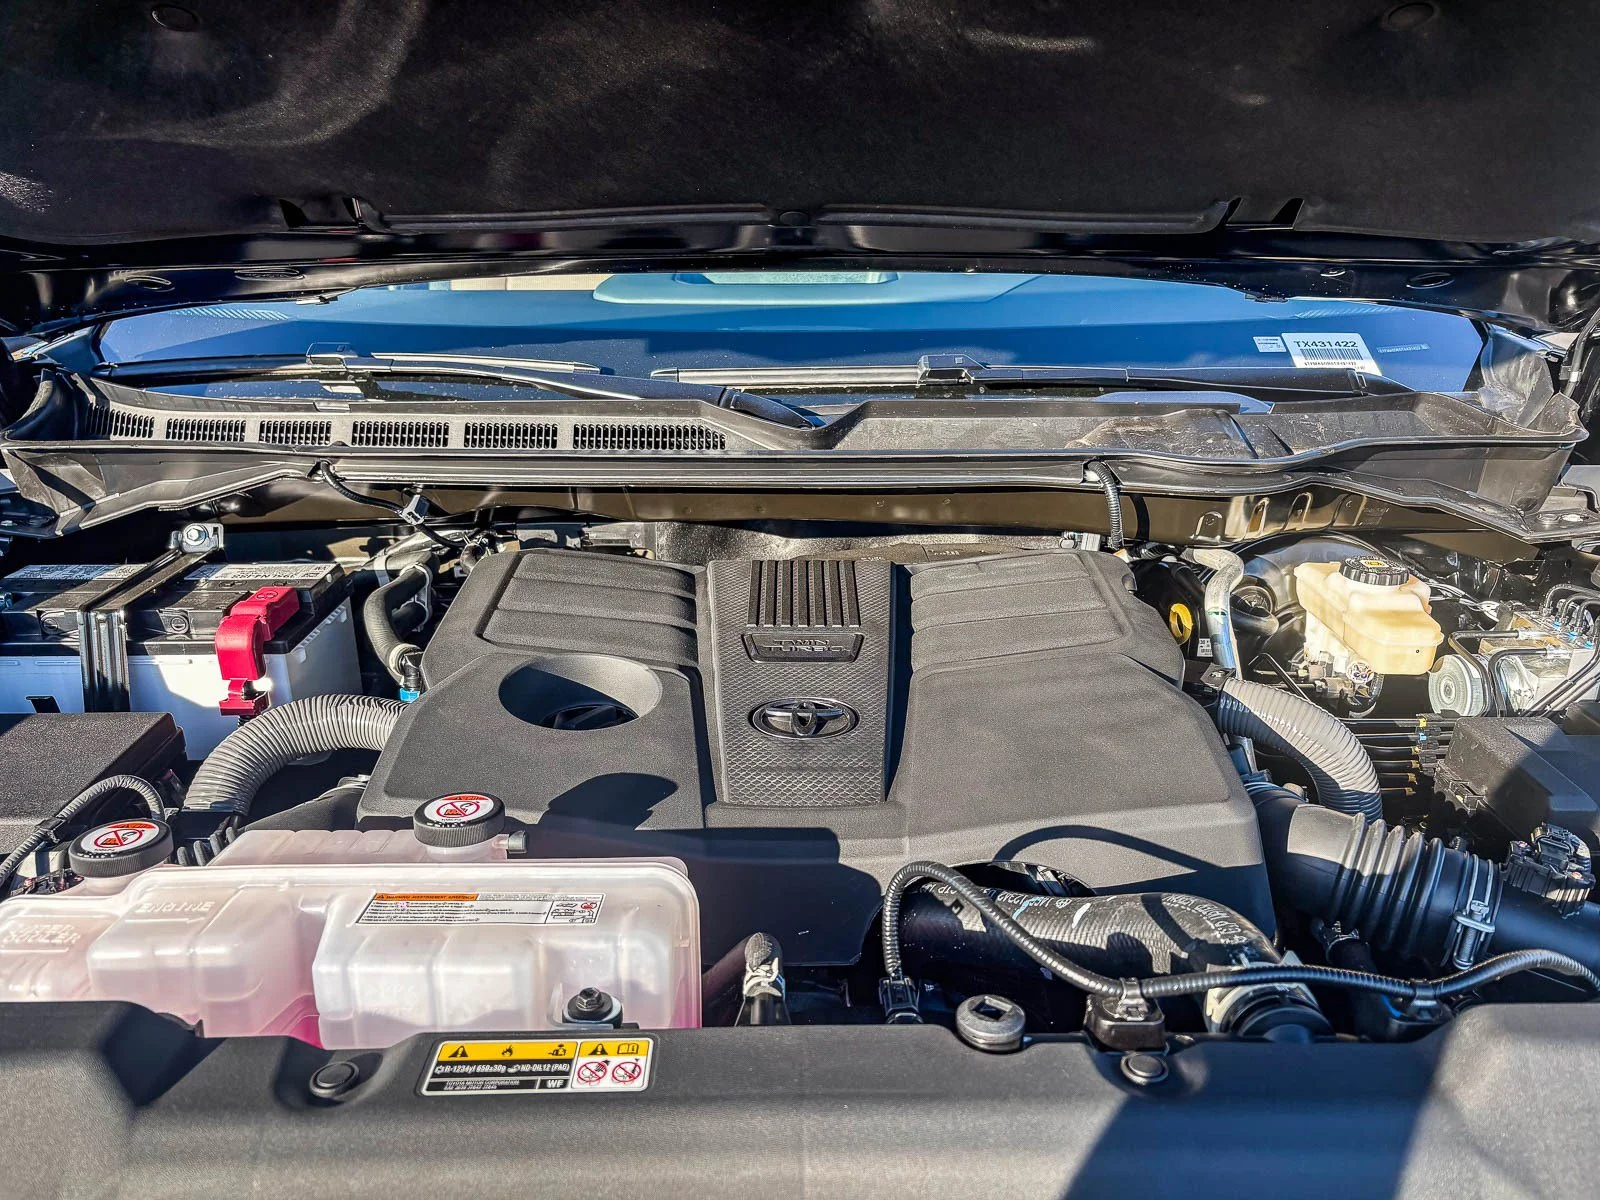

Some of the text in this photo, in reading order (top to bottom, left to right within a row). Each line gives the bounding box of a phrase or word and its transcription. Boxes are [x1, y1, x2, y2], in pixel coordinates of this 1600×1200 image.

[1293, 340, 1358, 348] TX431422
[136, 901, 215, 912] ENGINE
[546, 1080, 564, 1088] WF
